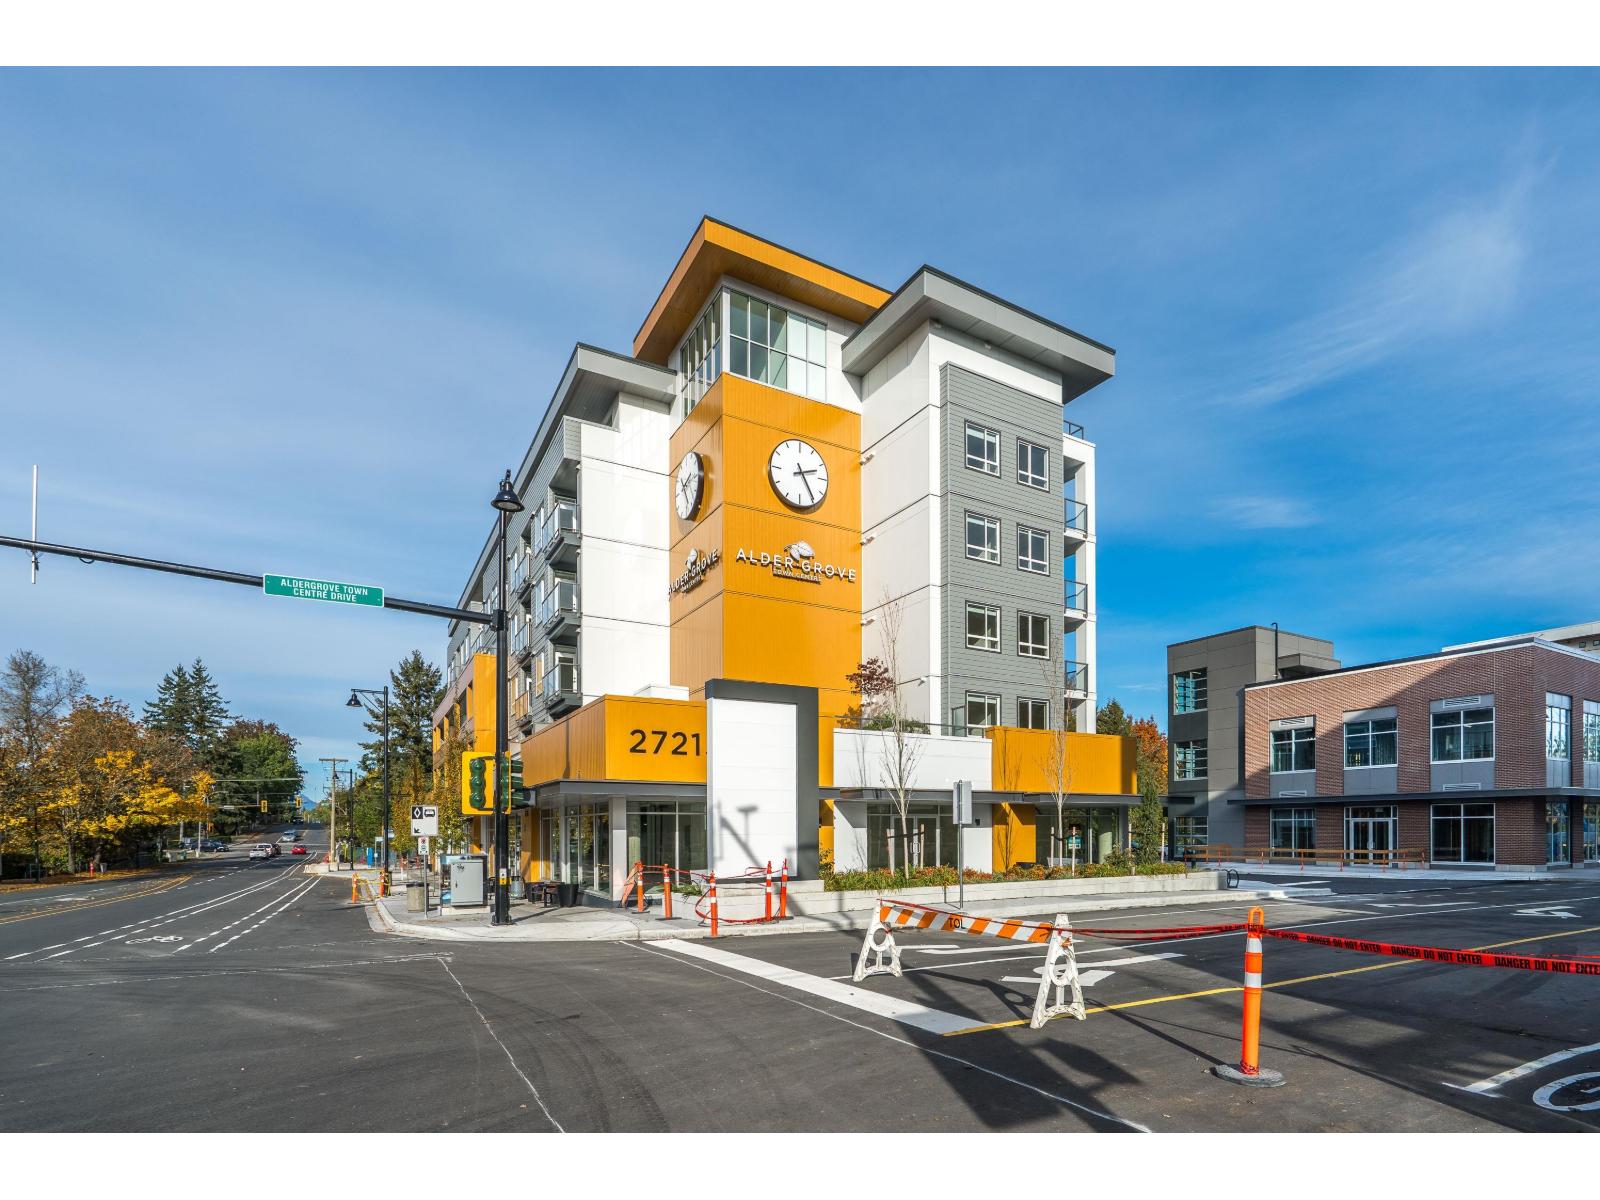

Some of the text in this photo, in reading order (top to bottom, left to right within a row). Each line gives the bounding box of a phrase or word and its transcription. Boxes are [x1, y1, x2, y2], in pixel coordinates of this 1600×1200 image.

[691, 549, 718, 576] GROVE
[736, 548, 856, 580] ALDER GROVE
[281, 579, 368, 595] ALDERGROVE TOWN
[293, 588, 357, 602] CENTRE DRIVE
[629, 729, 707, 756] 2721
[1359, 942, 1382, 953] ENTER
[1391, 945, 1482, 965] DANGER DO NOT ENTER
[1494, 956, 1600, 975] DANGER DO NOT ENTE
